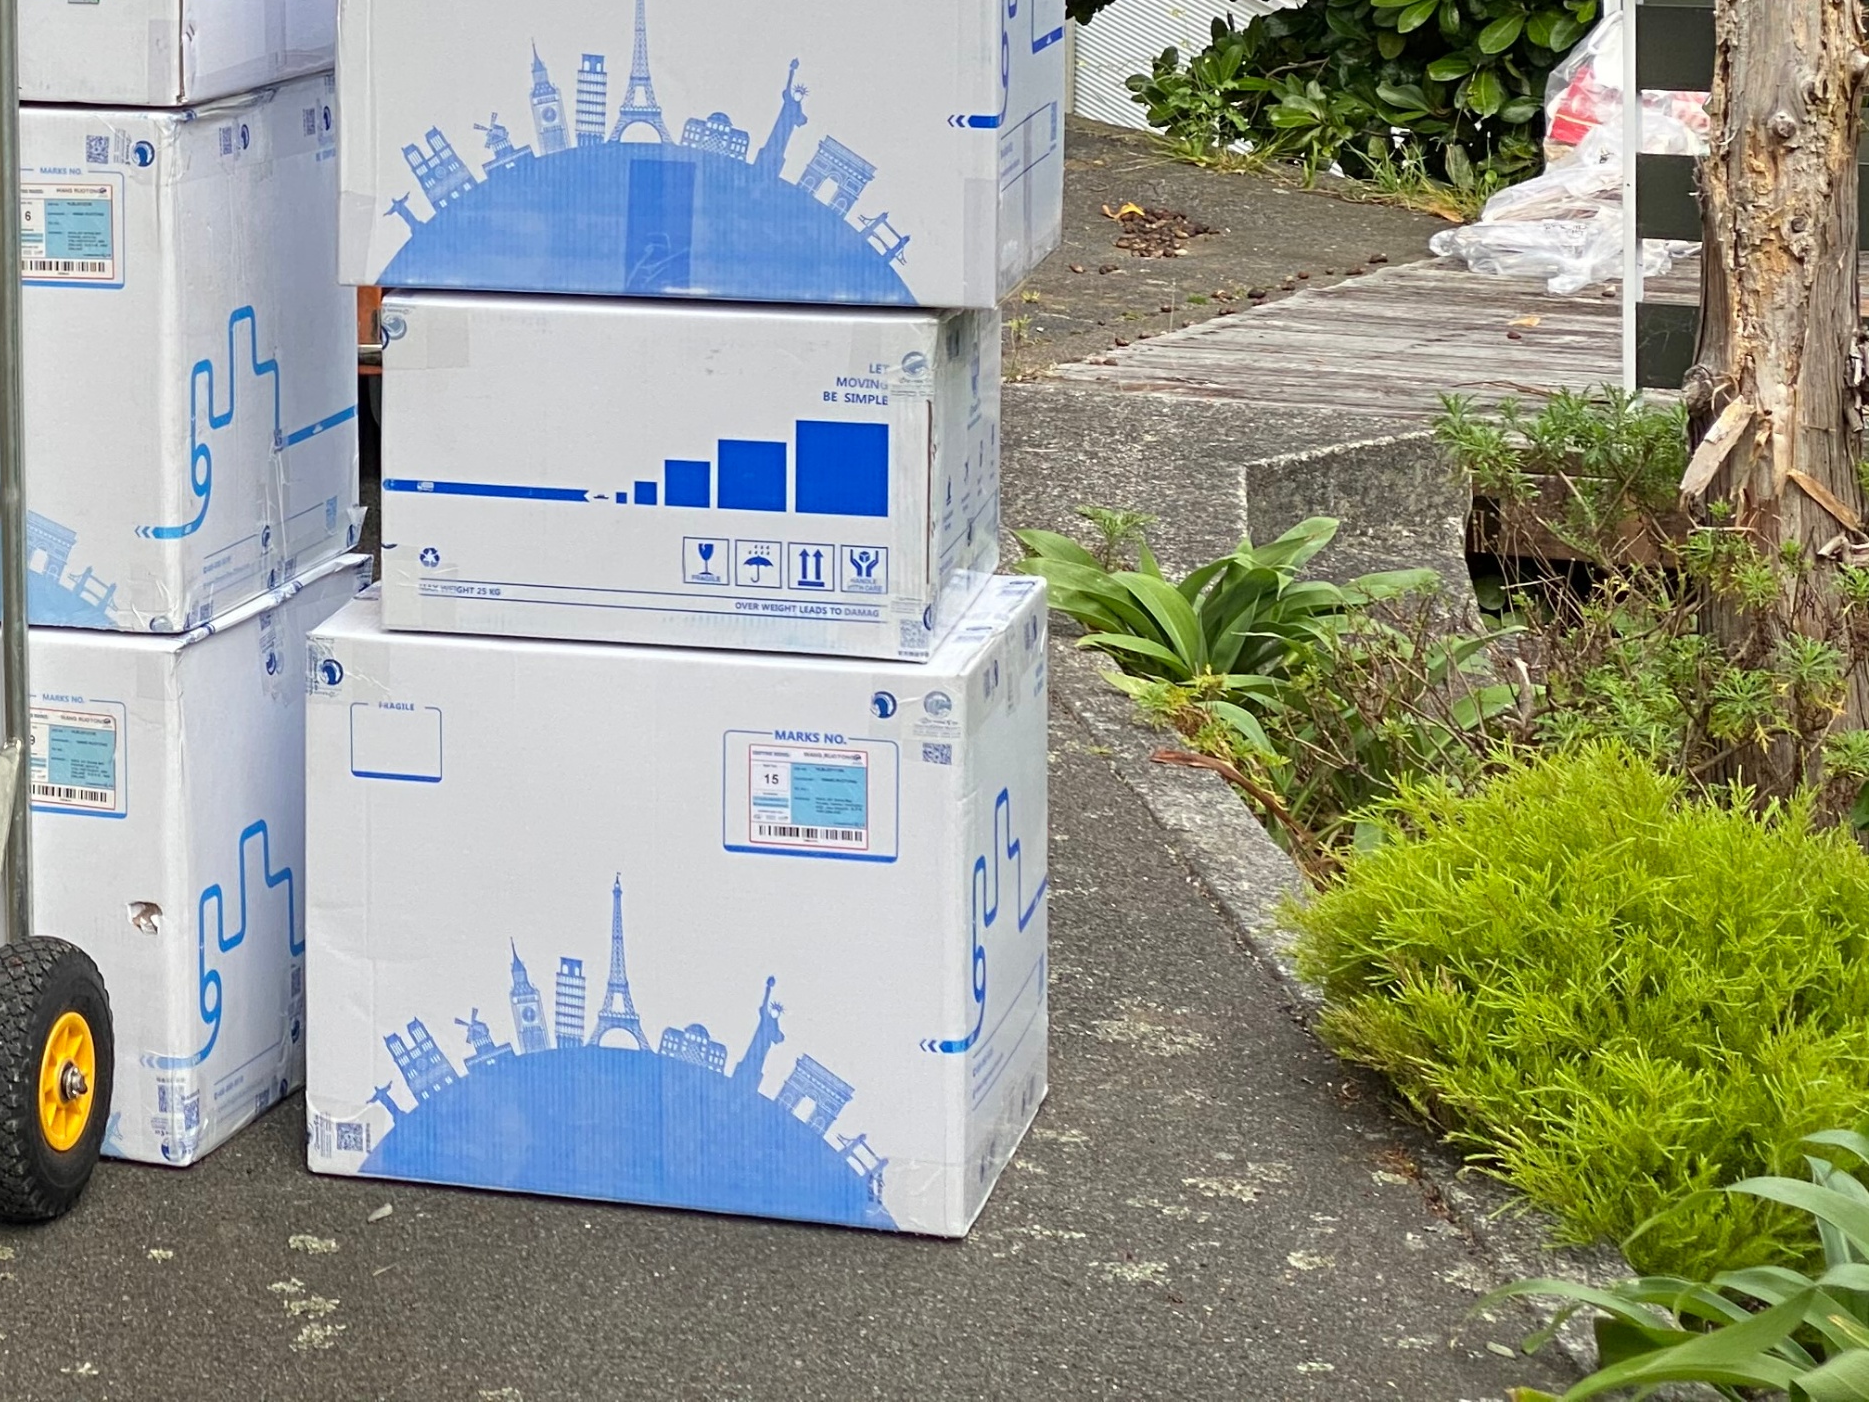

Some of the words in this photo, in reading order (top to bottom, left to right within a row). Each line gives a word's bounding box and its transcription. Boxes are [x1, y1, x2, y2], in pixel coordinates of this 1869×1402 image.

[40, 167, 68, 175] MARKS
[25, 210, 32, 222] 6
[869, 363, 890, 374] LET
[836, 376, 888, 390] MOVING
[823, 391, 838, 402] BE
[844, 392, 888, 406] SIMPLE
[476, 587, 487, 595] 25
[489, 588, 501, 596] KG
[735, 601, 759, 611] OVER
[761, 602, 797, 613] WEIGHT
[799, 605, 827, 615] LEADS
[829, 607, 842, 616] TO
[844, 608, 879, 618] DAMAG
[42, 693, 69, 703] MARKS
[71, 696, 85, 704] NO.
[378, 701, 415, 711] FRAGILE
[774, 729, 820, 743] MARKS
[823, 733, 848, 745] NO.
[764, 774, 779, 785] 15
